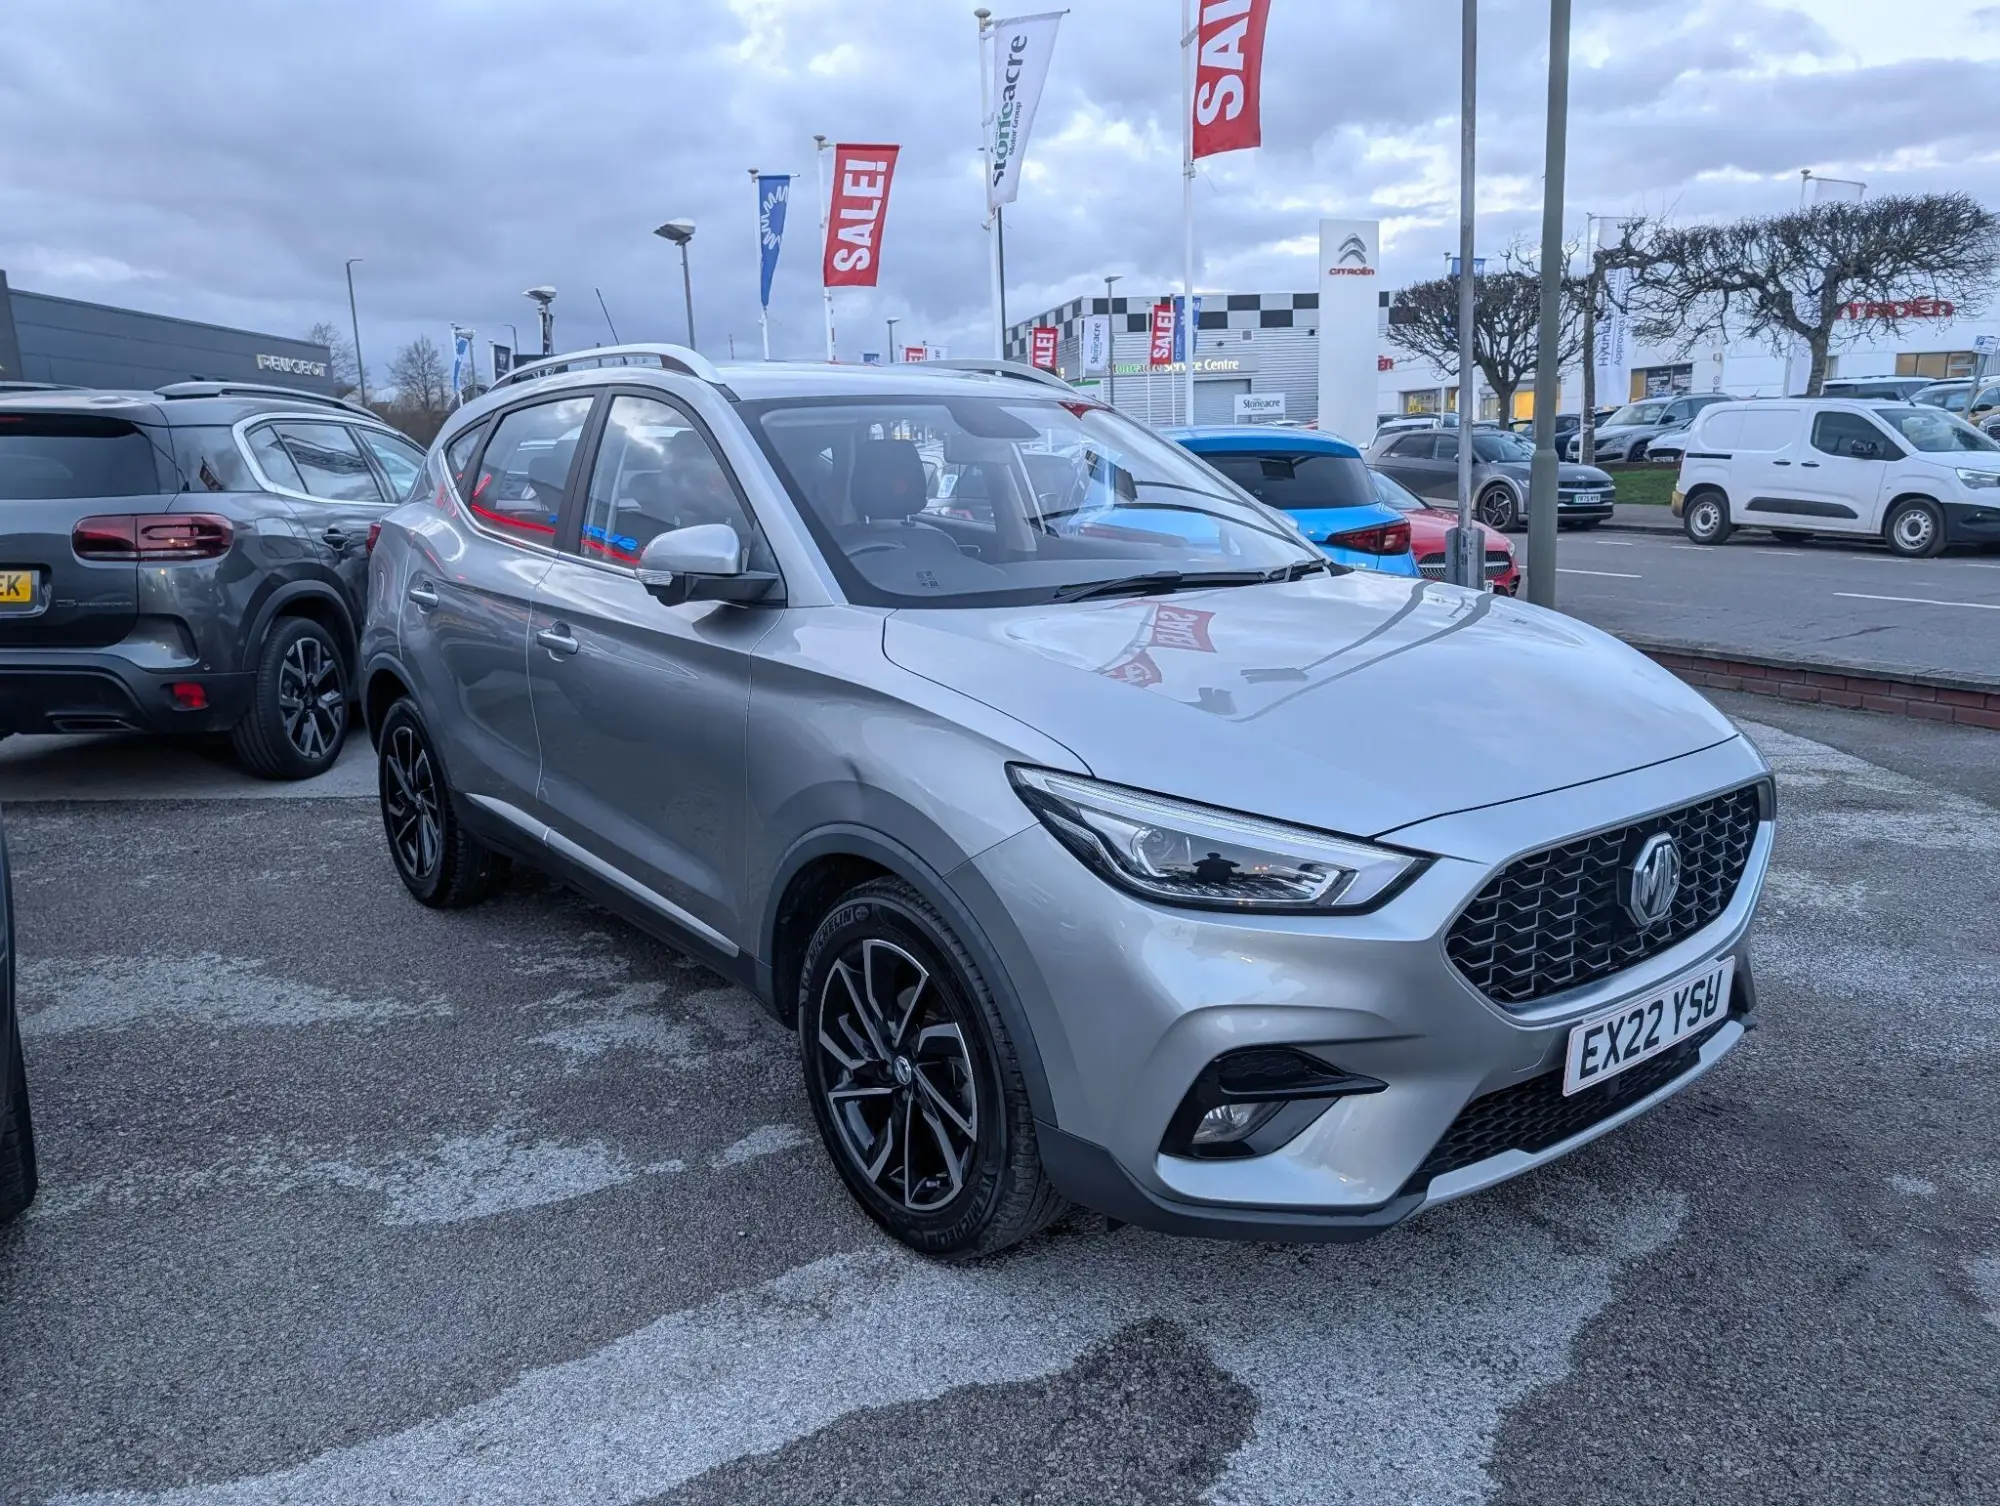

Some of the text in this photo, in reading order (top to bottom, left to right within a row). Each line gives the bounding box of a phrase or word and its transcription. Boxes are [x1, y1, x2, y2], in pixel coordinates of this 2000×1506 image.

[1009, 101, 1023, 156] Motor Group
[833, 159, 888, 272] SALE!
[1035, 332, 1055, 367] ALE!
[1204, 359, 1240, 371] Centre
[1243, 398, 1280, 408] Stoneacre
[1578, 969, 1723, 1080] EX22 YSU
